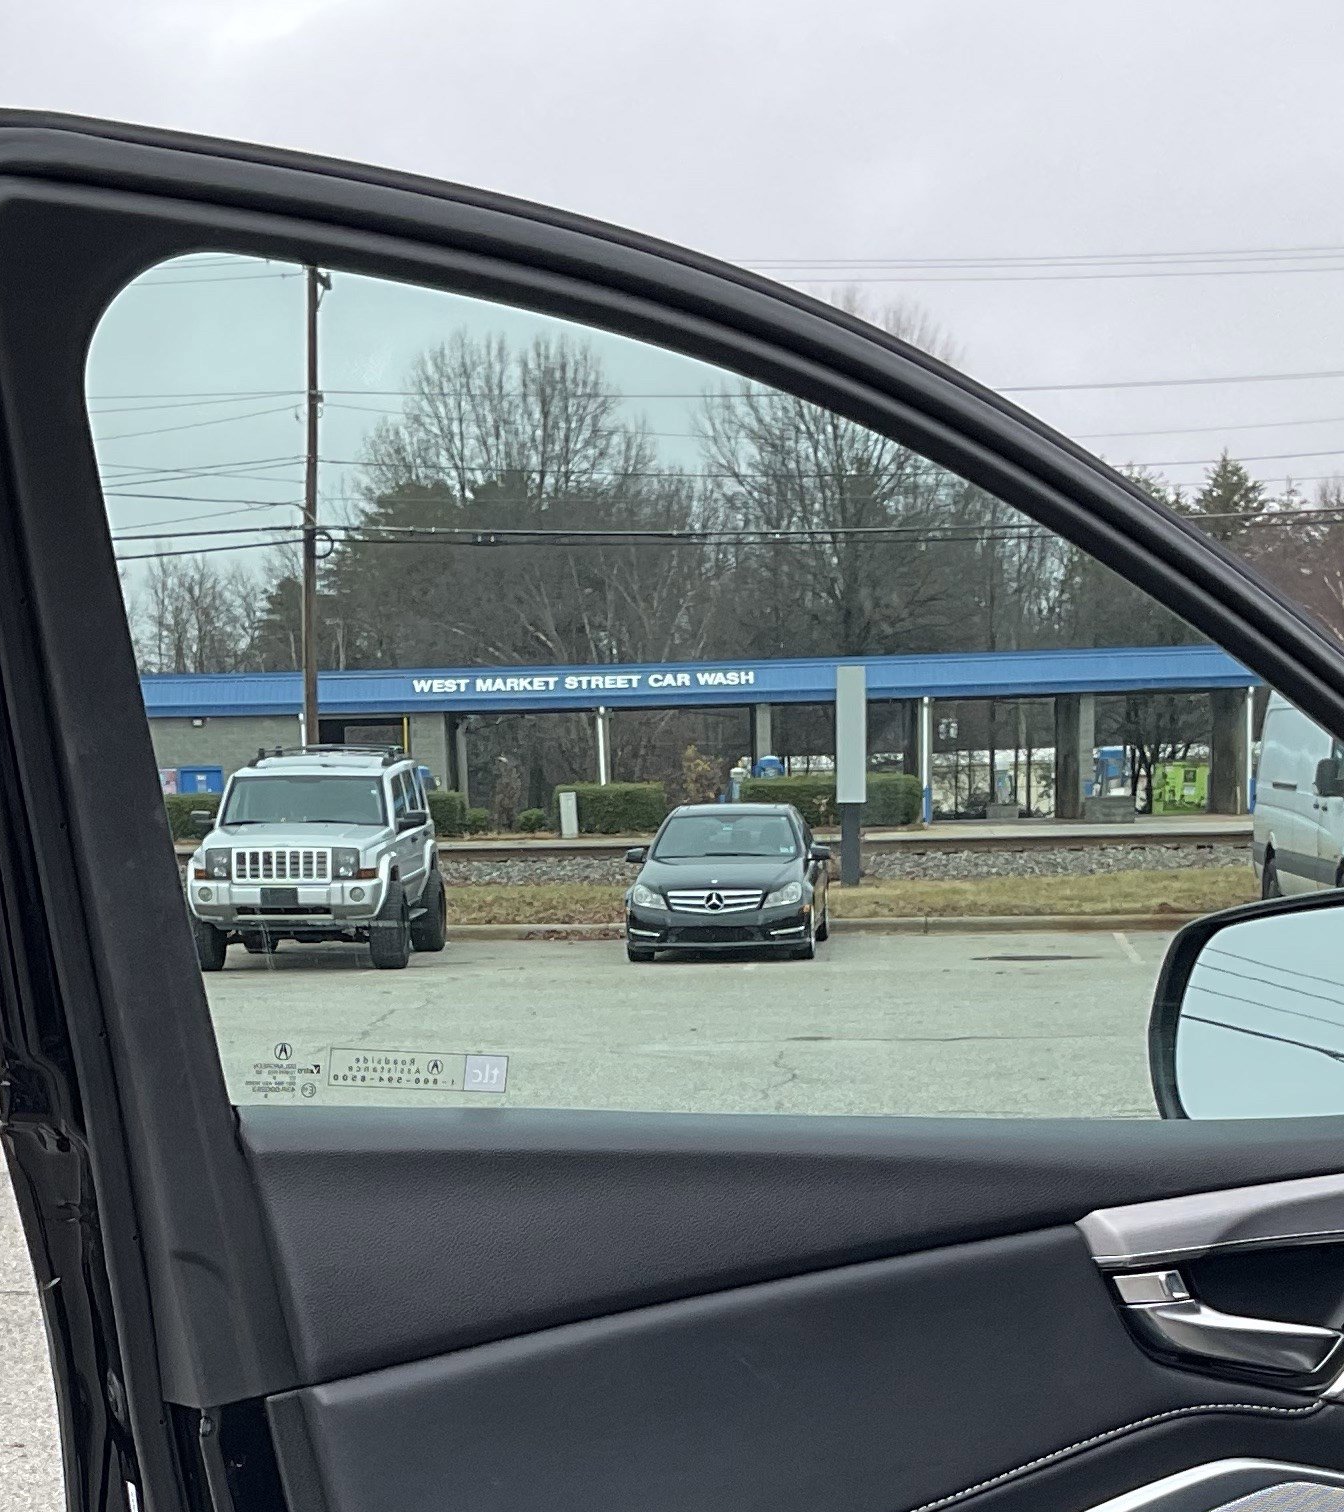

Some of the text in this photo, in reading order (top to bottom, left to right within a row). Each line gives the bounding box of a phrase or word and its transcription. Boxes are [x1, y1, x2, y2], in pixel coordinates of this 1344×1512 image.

[413, 671, 755, 693] WEST MARKET STREET CAR WASH
